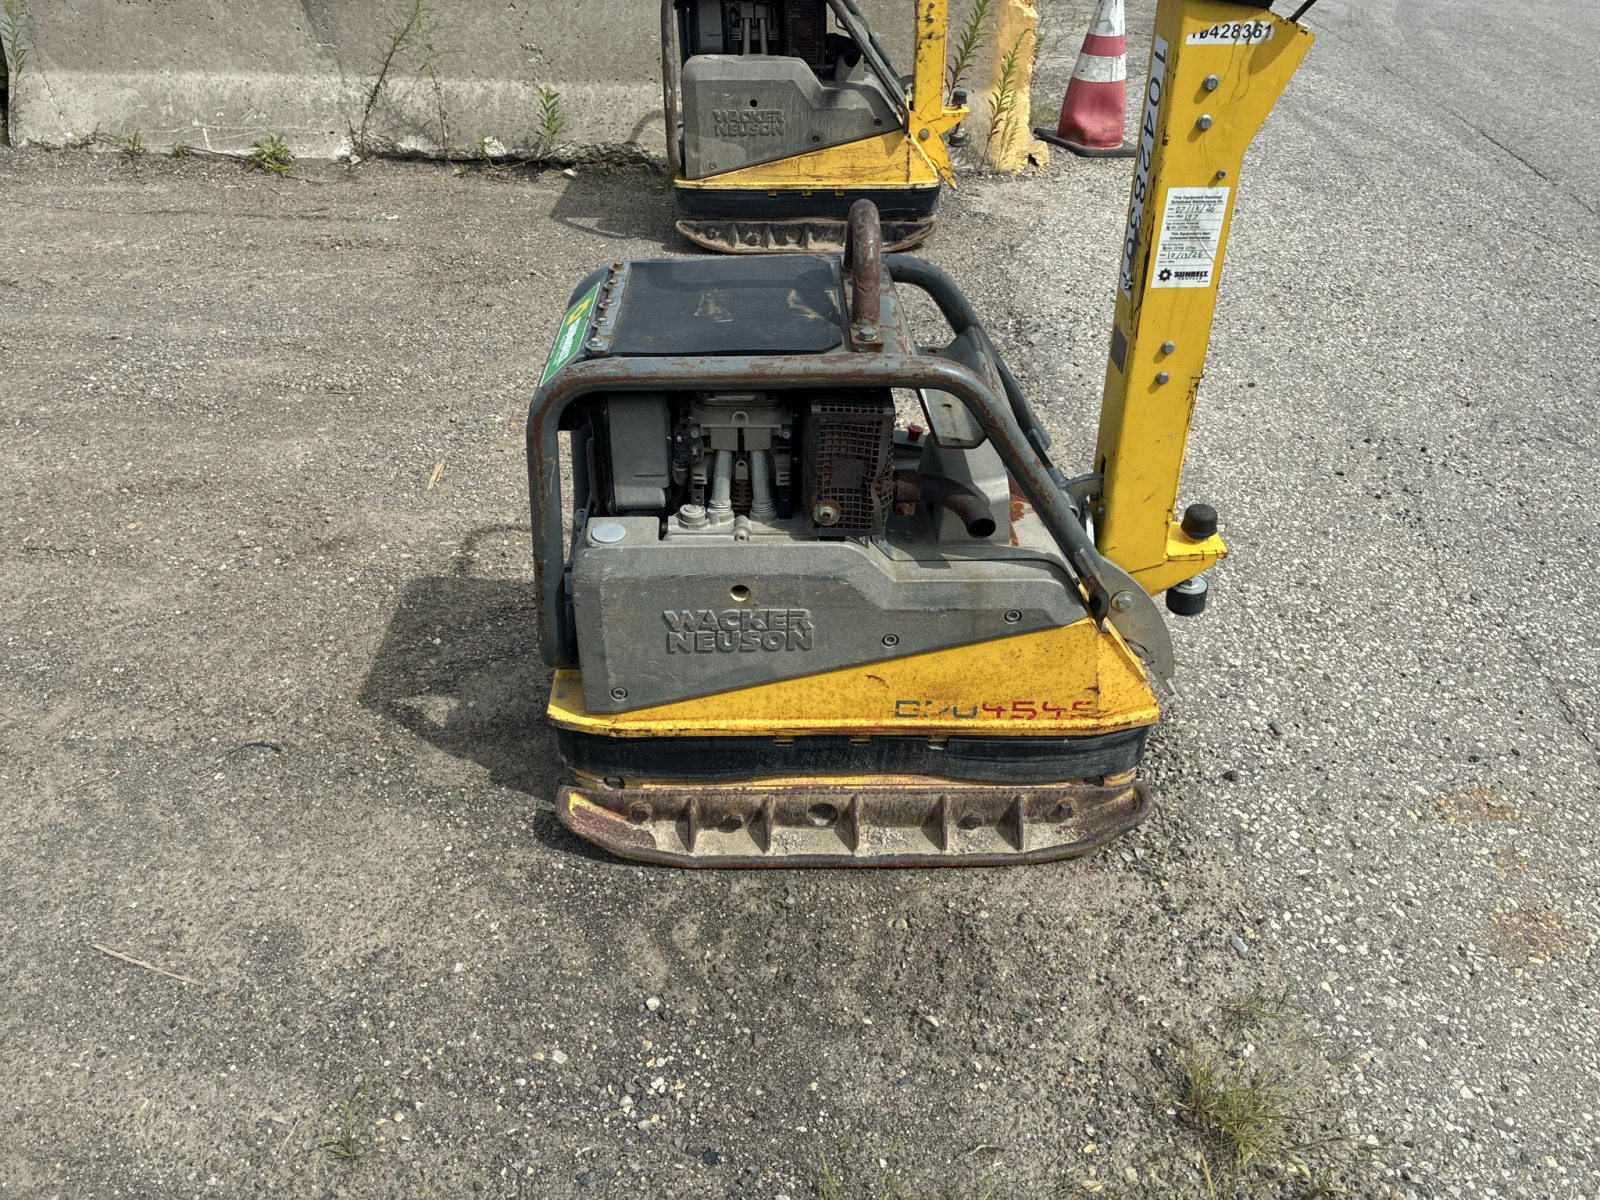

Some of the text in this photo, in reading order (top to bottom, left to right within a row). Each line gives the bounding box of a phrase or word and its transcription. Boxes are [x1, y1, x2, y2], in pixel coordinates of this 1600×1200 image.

[713, 109, 785, 123] WACKER
[714, 122, 785, 137] NEUSON
[661, 608, 815, 632] WACKER
[666, 630, 814, 655] NEUSON
[894, 699, 1093, 720] DU4545
